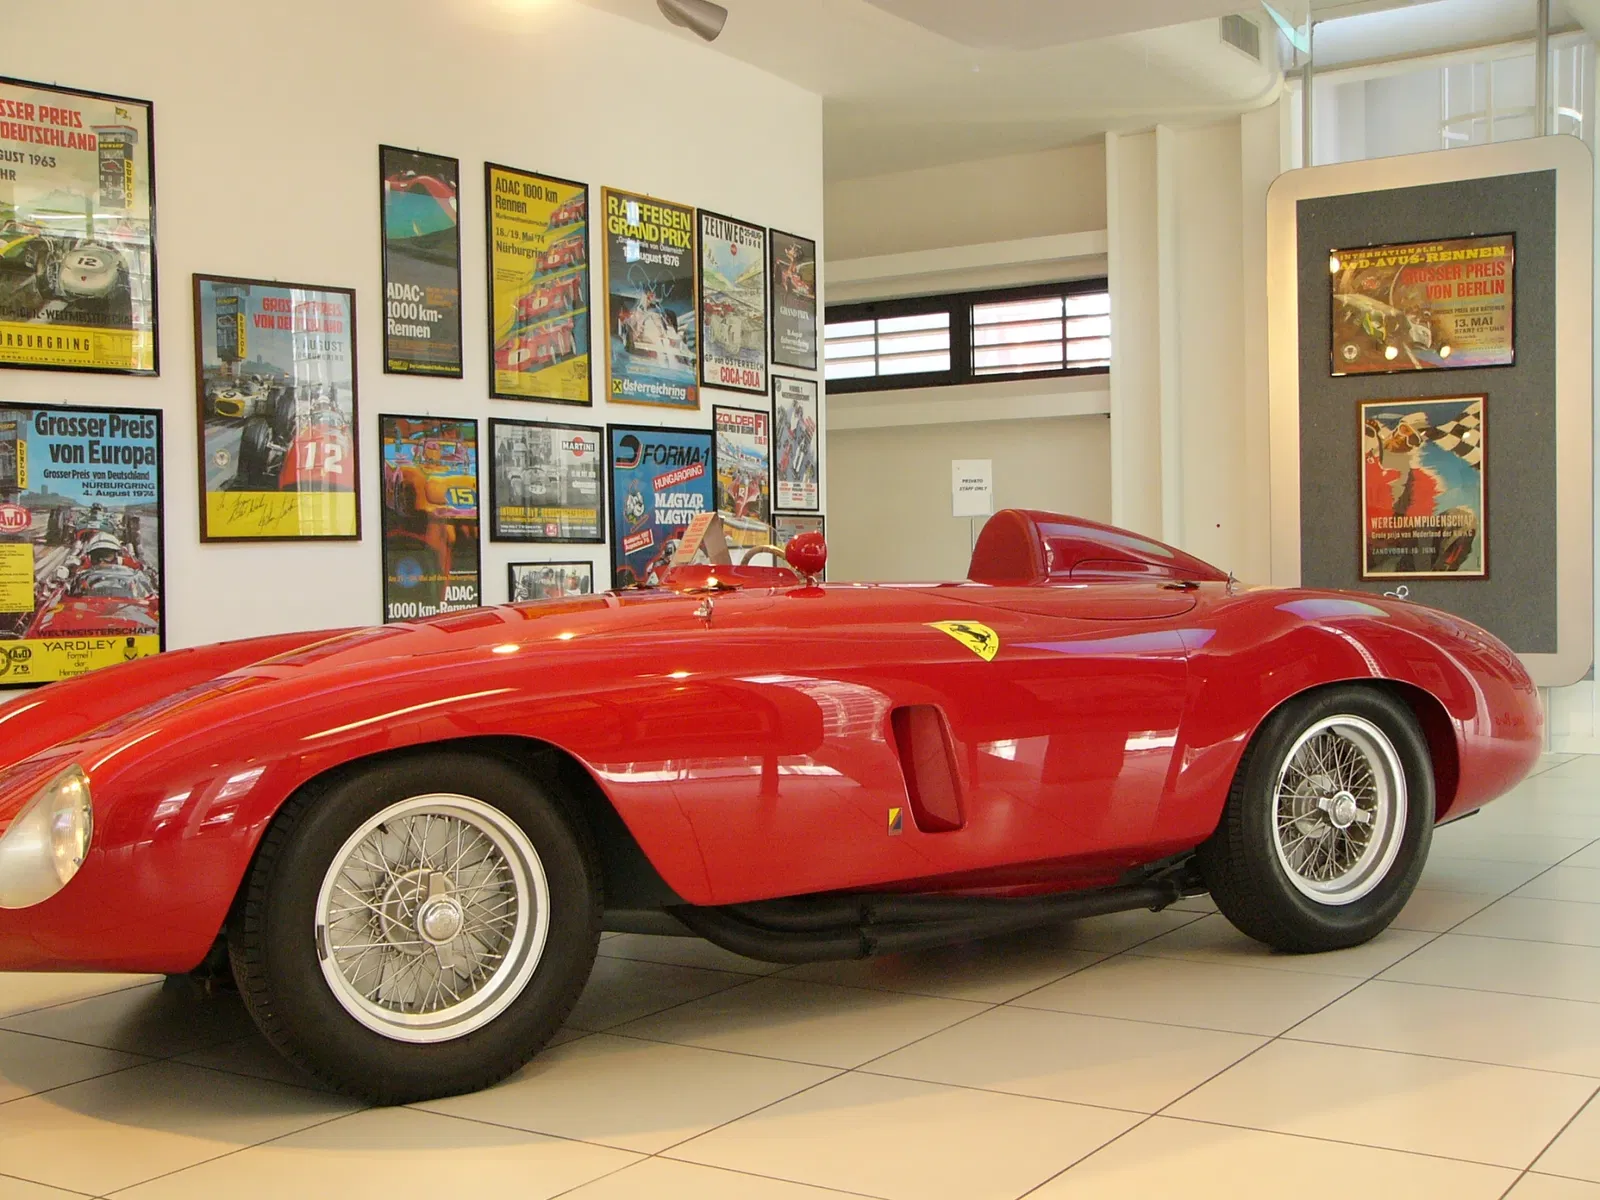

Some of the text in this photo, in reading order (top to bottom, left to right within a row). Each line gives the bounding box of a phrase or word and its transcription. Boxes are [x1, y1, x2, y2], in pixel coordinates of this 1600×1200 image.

[39, 105, 83, 128] PREIS
[0, 121, 97, 152] DEUTSCHLAND
[29, 153, 56, 168] 1963
[495, 177, 558, 204] ADAC 1000 km
[495, 194, 527, 214] Rennen
[608, 216, 692, 250] GRAND PRIX
[704, 216, 744, 245] ZELTWEG
[77, 256, 97, 267] 12
[663, 254, 680, 268] 1976
[1402, 261, 1505, 286] GROSSER PREIS
[387, 282, 424, 302] ADAC-
[1426, 279, 1505, 300] VON BERLIN
[254, 313, 275, 329] VON
[387, 301, 442, 322] 1000 km-
[388, 318, 431, 338] Rennen
[1454, 316, 1493, 328] 13. MAI
[720, 366, 761, 389] COCA-COLA
[35, 411, 155, 439] Grosser Preis
[717, 413, 754, 426] ZOLDER
[49, 440, 155, 469] von Europa
[562, 441, 595, 452] MARTINI
[642, 444, 710, 467] FORMA-1
[304, 441, 343, 474] 12
[43, 468, 71, 479] Grosser
[71, 469, 90, 480] Preis
[107, 470, 150, 480] Deutschland
[653, 464, 703, 490] HUNGARORING
[95, 490, 130, 498] August
[450, 488, 474, 505] 15
[654, 493, 704, 508] MAGYAR
[1371, 514, 1474, 529] WERELDKAMPIOENSCHAP
[445, 585, 478, 602] ADAC-
[388, 602, 417, 619] 1000
[37, 627, 157, 637] WELTMEISTERSCHAFT
[43, 640, 117, 651] YARDLEY
